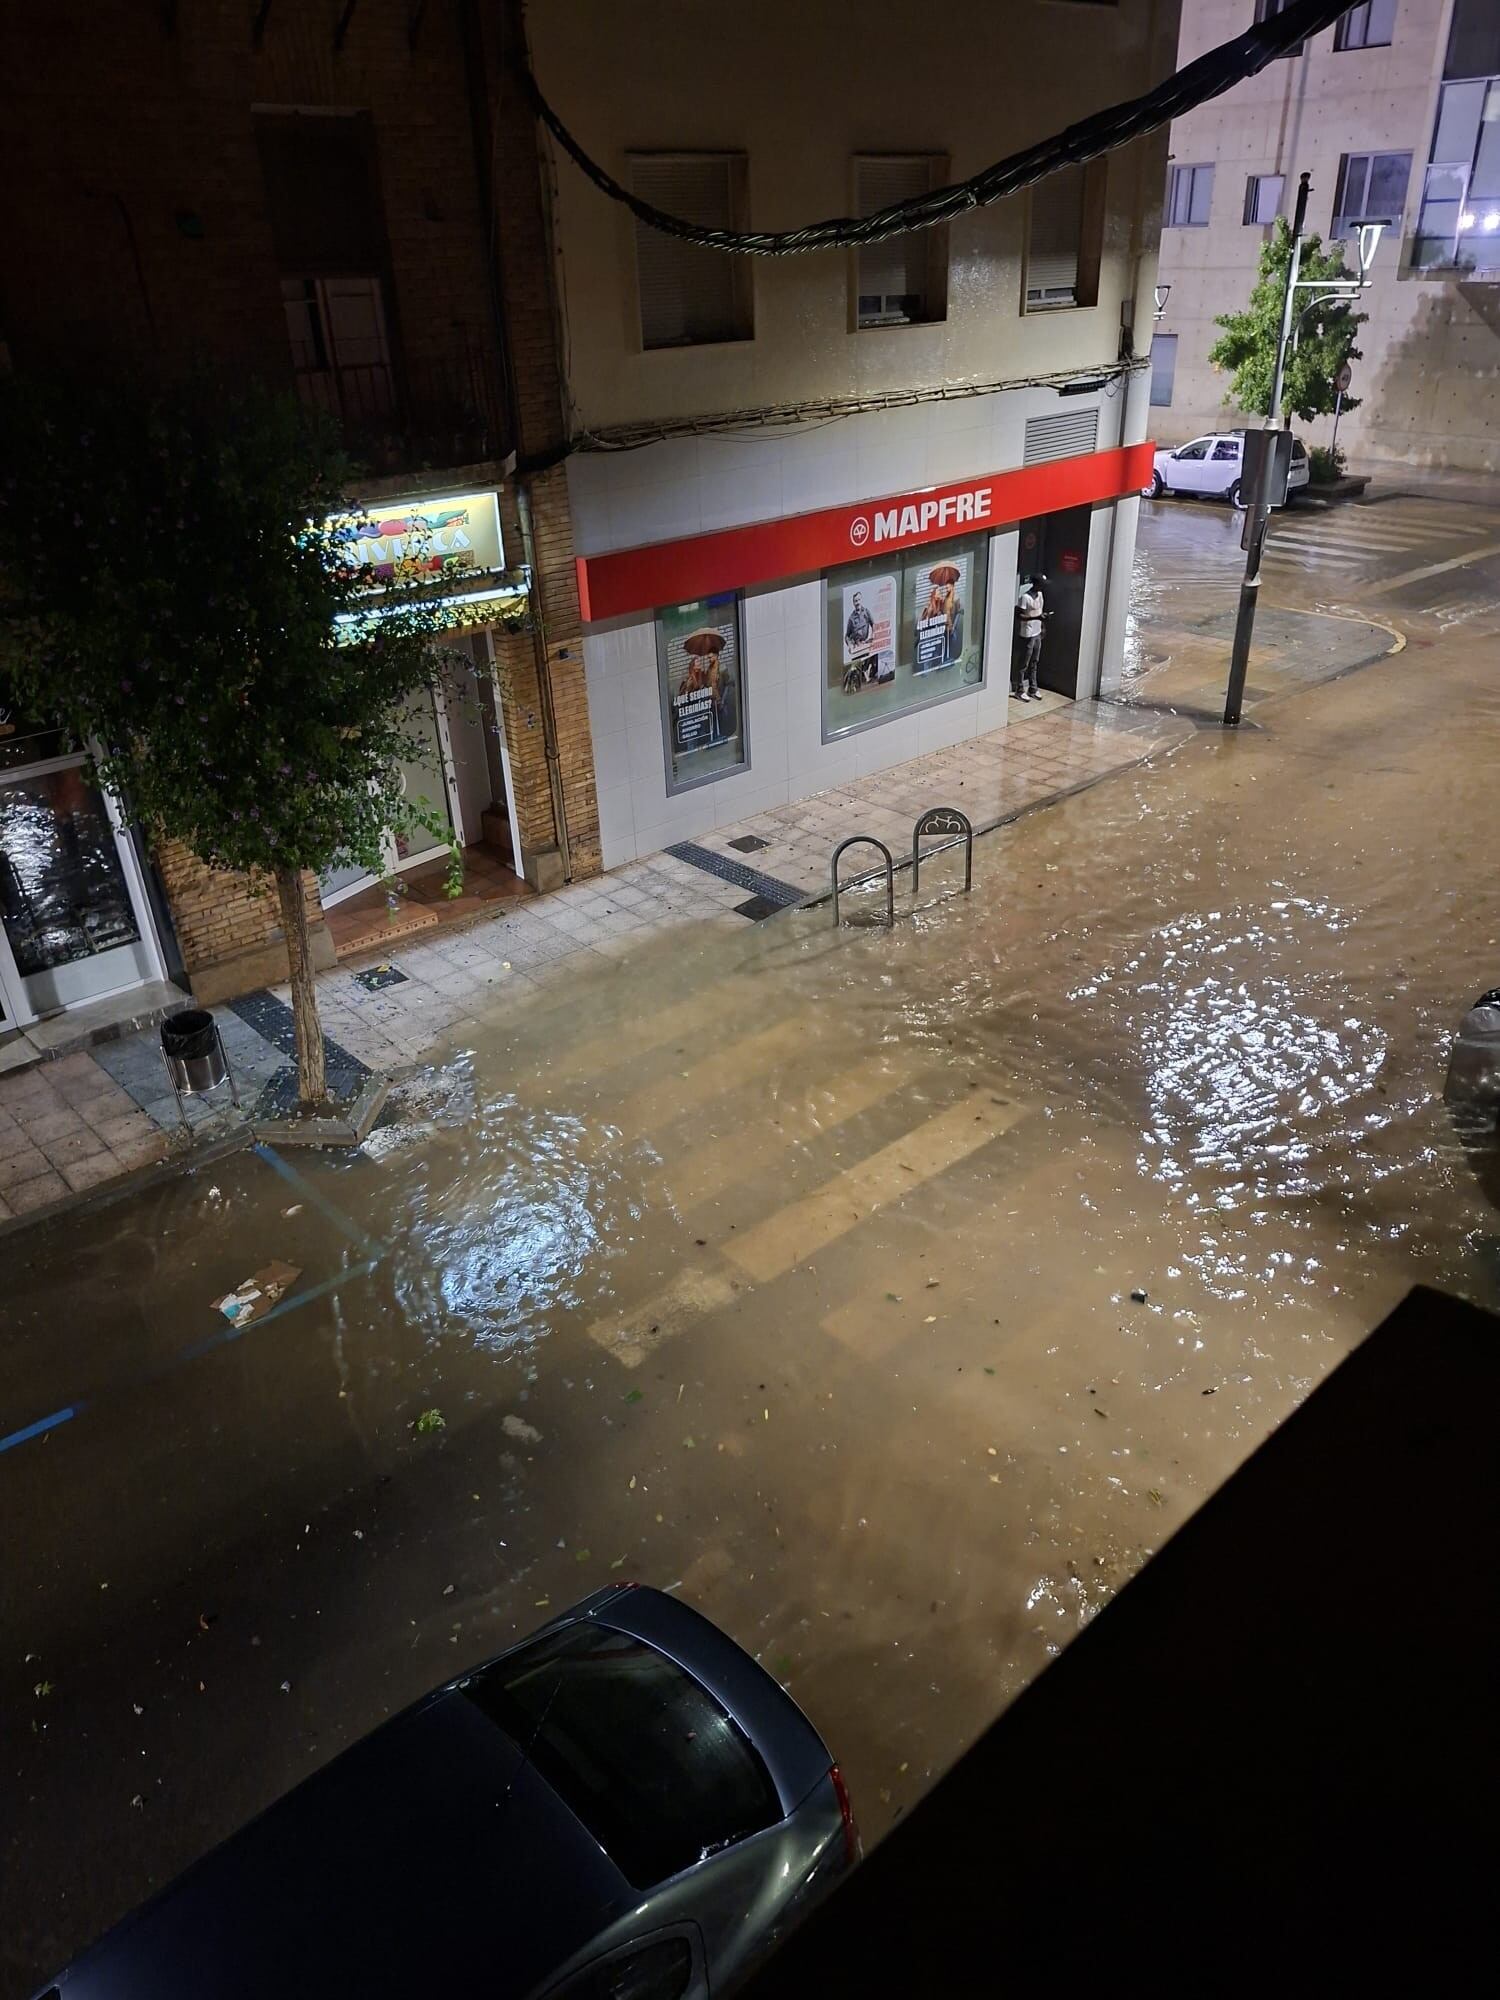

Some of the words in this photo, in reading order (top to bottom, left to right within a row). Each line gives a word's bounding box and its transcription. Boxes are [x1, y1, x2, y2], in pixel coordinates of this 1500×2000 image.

[874, 488, 992, 542] MAPFRE
[673, 692, 689, 707] ¿QUÉ
[690, 686, 713, 703] SEGURO
[678, 699, 713, 718] ELEGIRÍAS?
